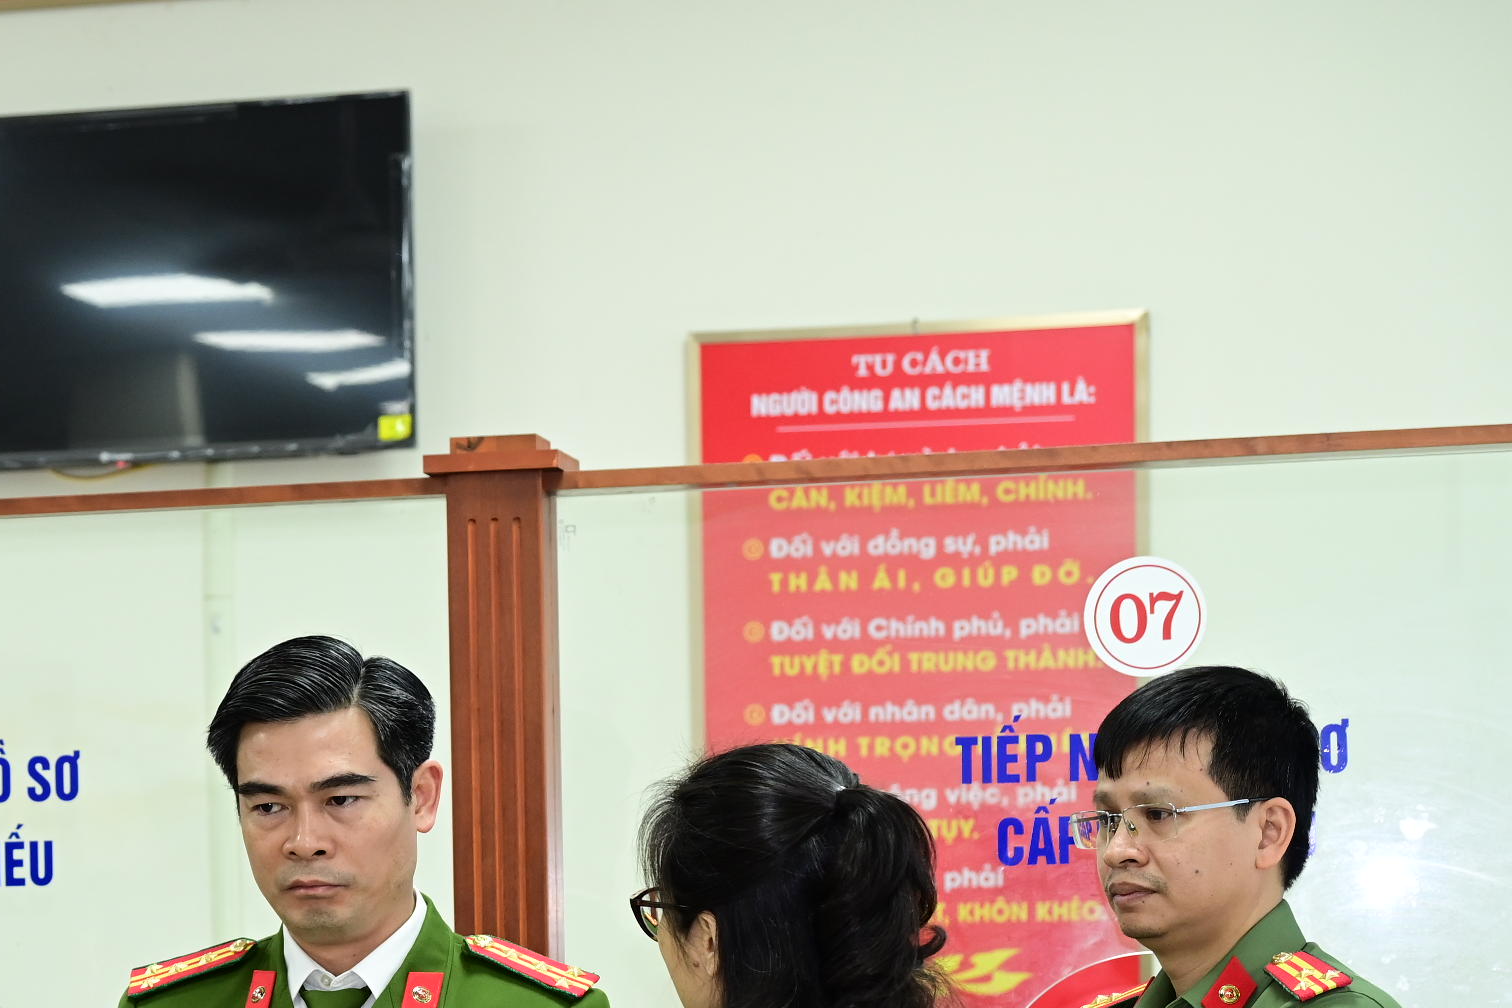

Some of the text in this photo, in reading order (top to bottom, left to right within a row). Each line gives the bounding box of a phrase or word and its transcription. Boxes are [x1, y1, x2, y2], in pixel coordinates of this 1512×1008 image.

[901, 345, 991, 375] CÁCH
[824, 385, 884, 414] CÔNG
[889, 387, 921, 411] AN
[925, 381, 986, 409] CÁCH
[820, 532, 860, 558] với
[821, 617, 860, 641] với
[868, 614, 945, 640] Chính
[1109, 590, 1185, 645] 07
[908, 649, 997, 674] TRUNG
[822, 702, 862, 725] với
[869, 700, 935, 724] nhân
[955, 714, 1053, 785] TIẾP
[27, 750, 81, 802] SƠ
